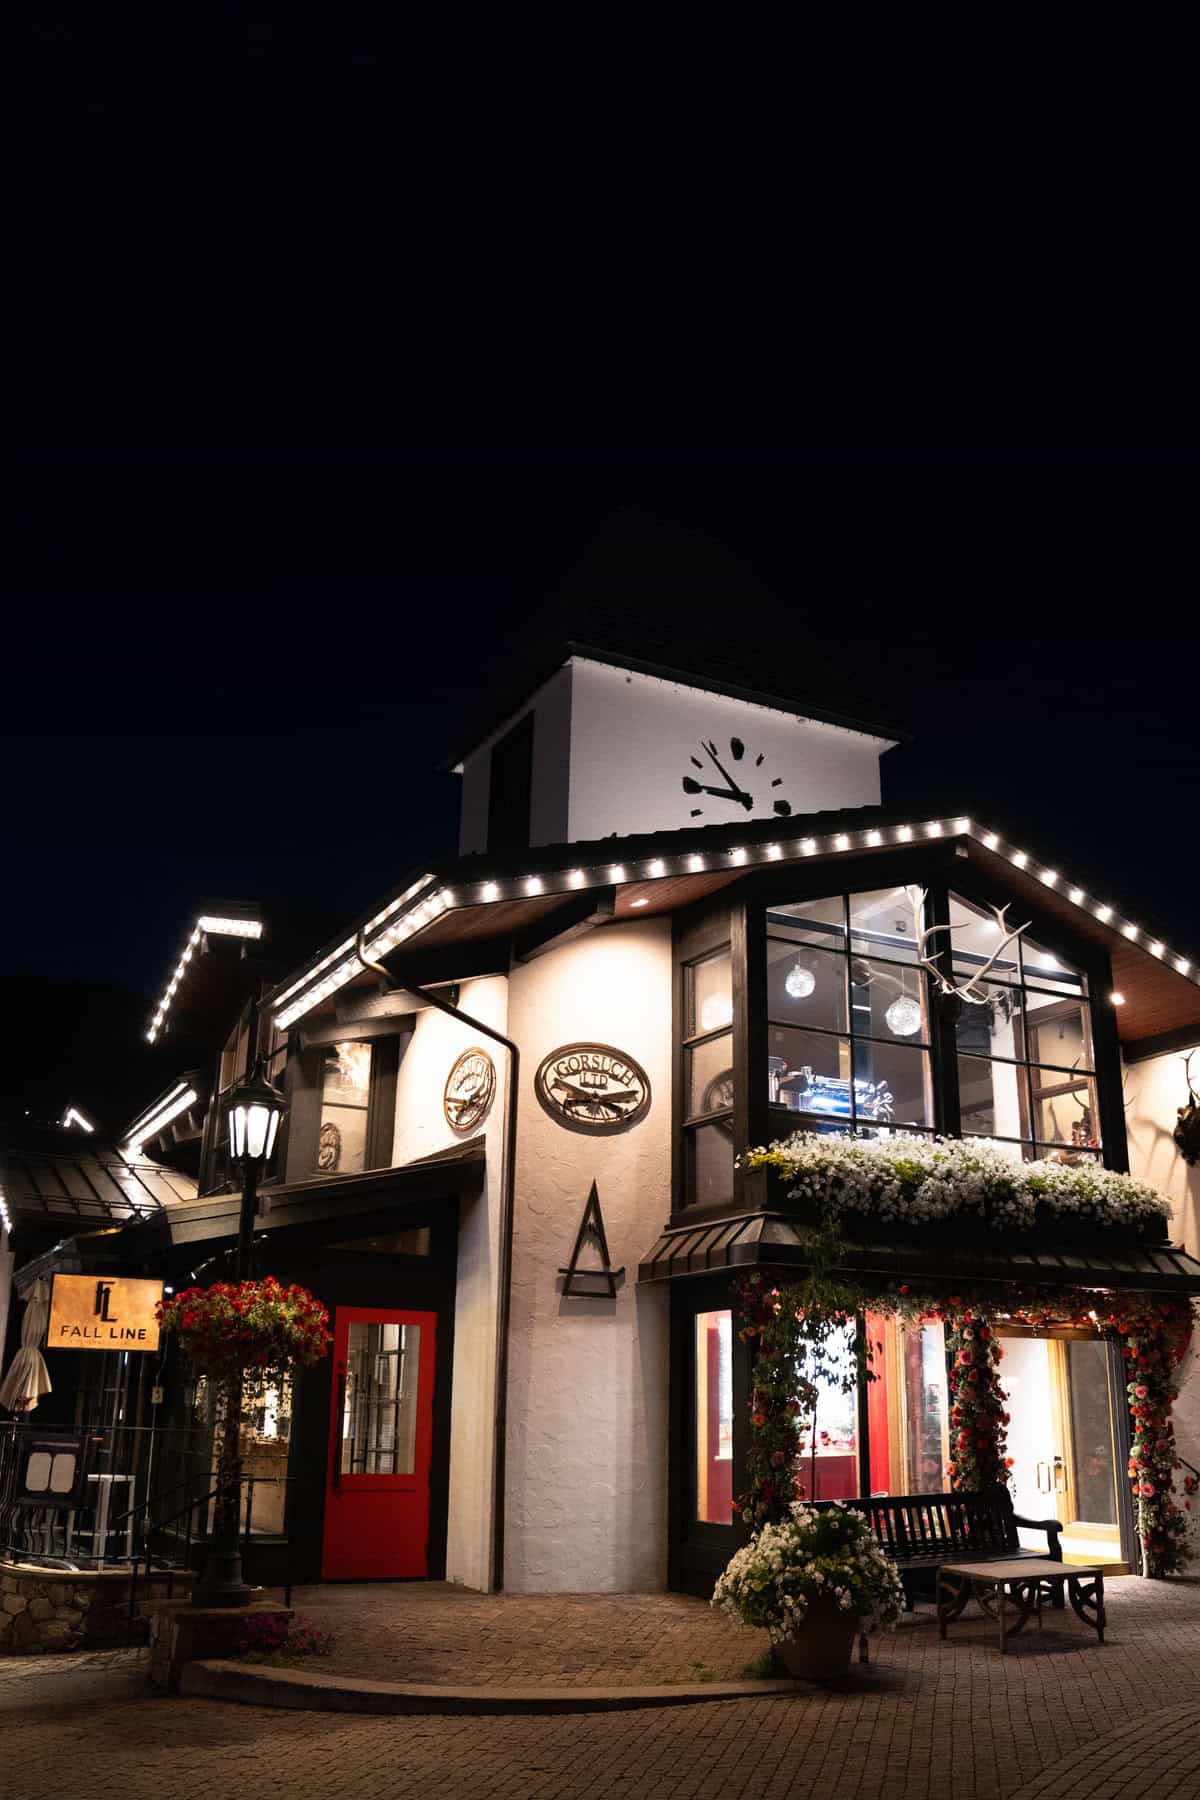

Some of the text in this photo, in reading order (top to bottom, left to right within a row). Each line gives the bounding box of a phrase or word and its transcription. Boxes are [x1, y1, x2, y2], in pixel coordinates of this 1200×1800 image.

[554, 1055, 635, 1087] GORSUCH
[581, 1072, 608, 1087] LTD
[60, 1325, 147, 1340] FALL LINE
